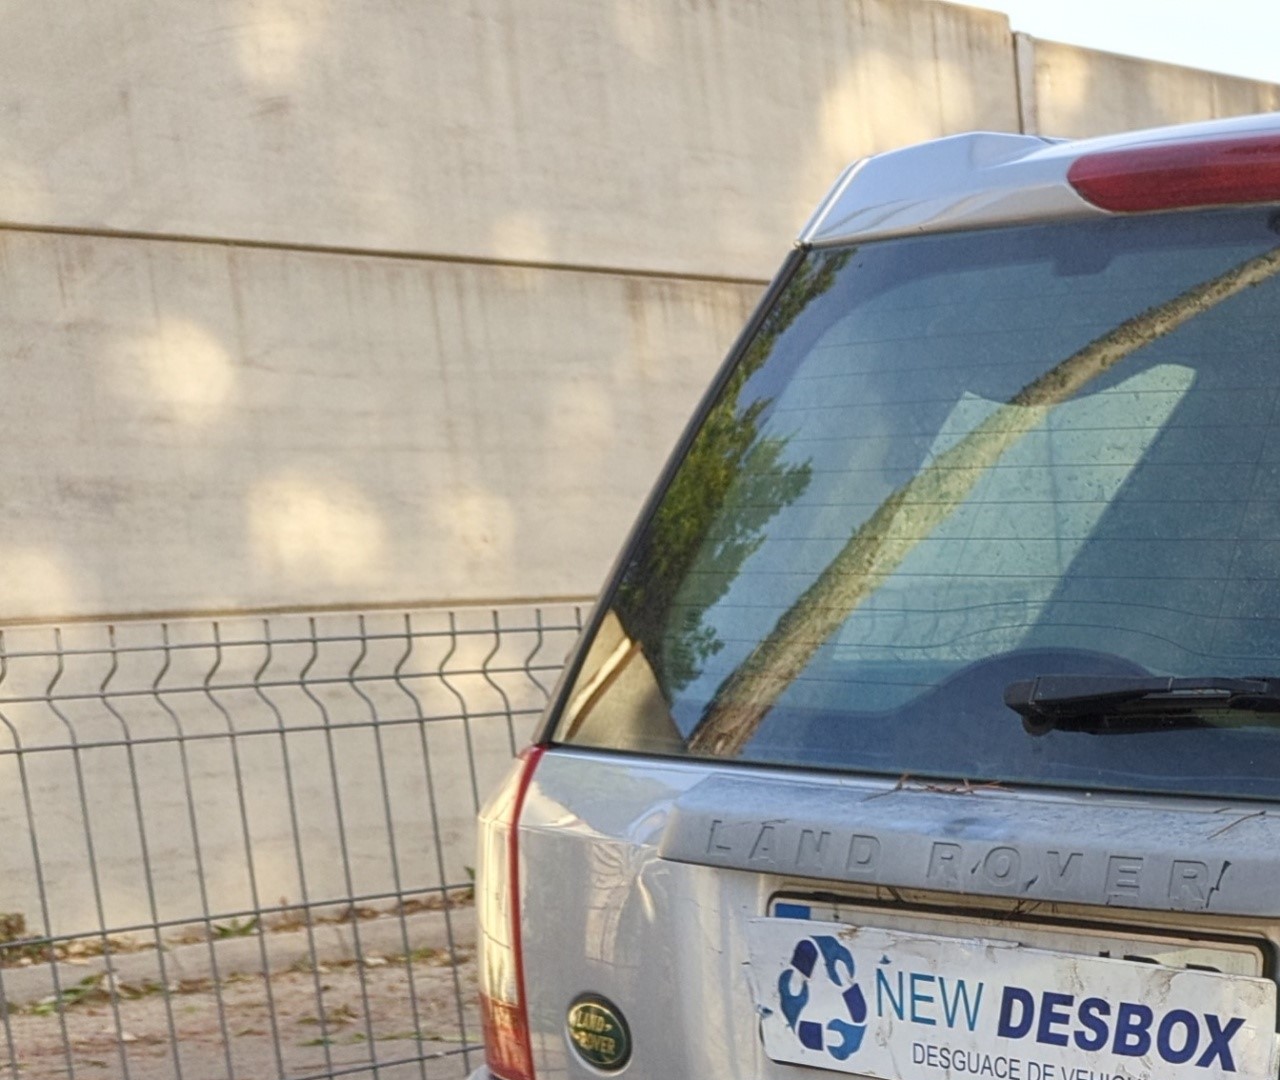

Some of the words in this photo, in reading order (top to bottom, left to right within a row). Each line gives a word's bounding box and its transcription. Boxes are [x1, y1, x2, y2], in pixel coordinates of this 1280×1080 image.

[706, 820, 882, 873] LAND
[927, 841, 1211, 902] ROVER
[875, 967, 984, 1031] NEW
[997, 986, 1246, 1072] DESBOX
[912, 1042, 1021, 1080] DESGUACE
